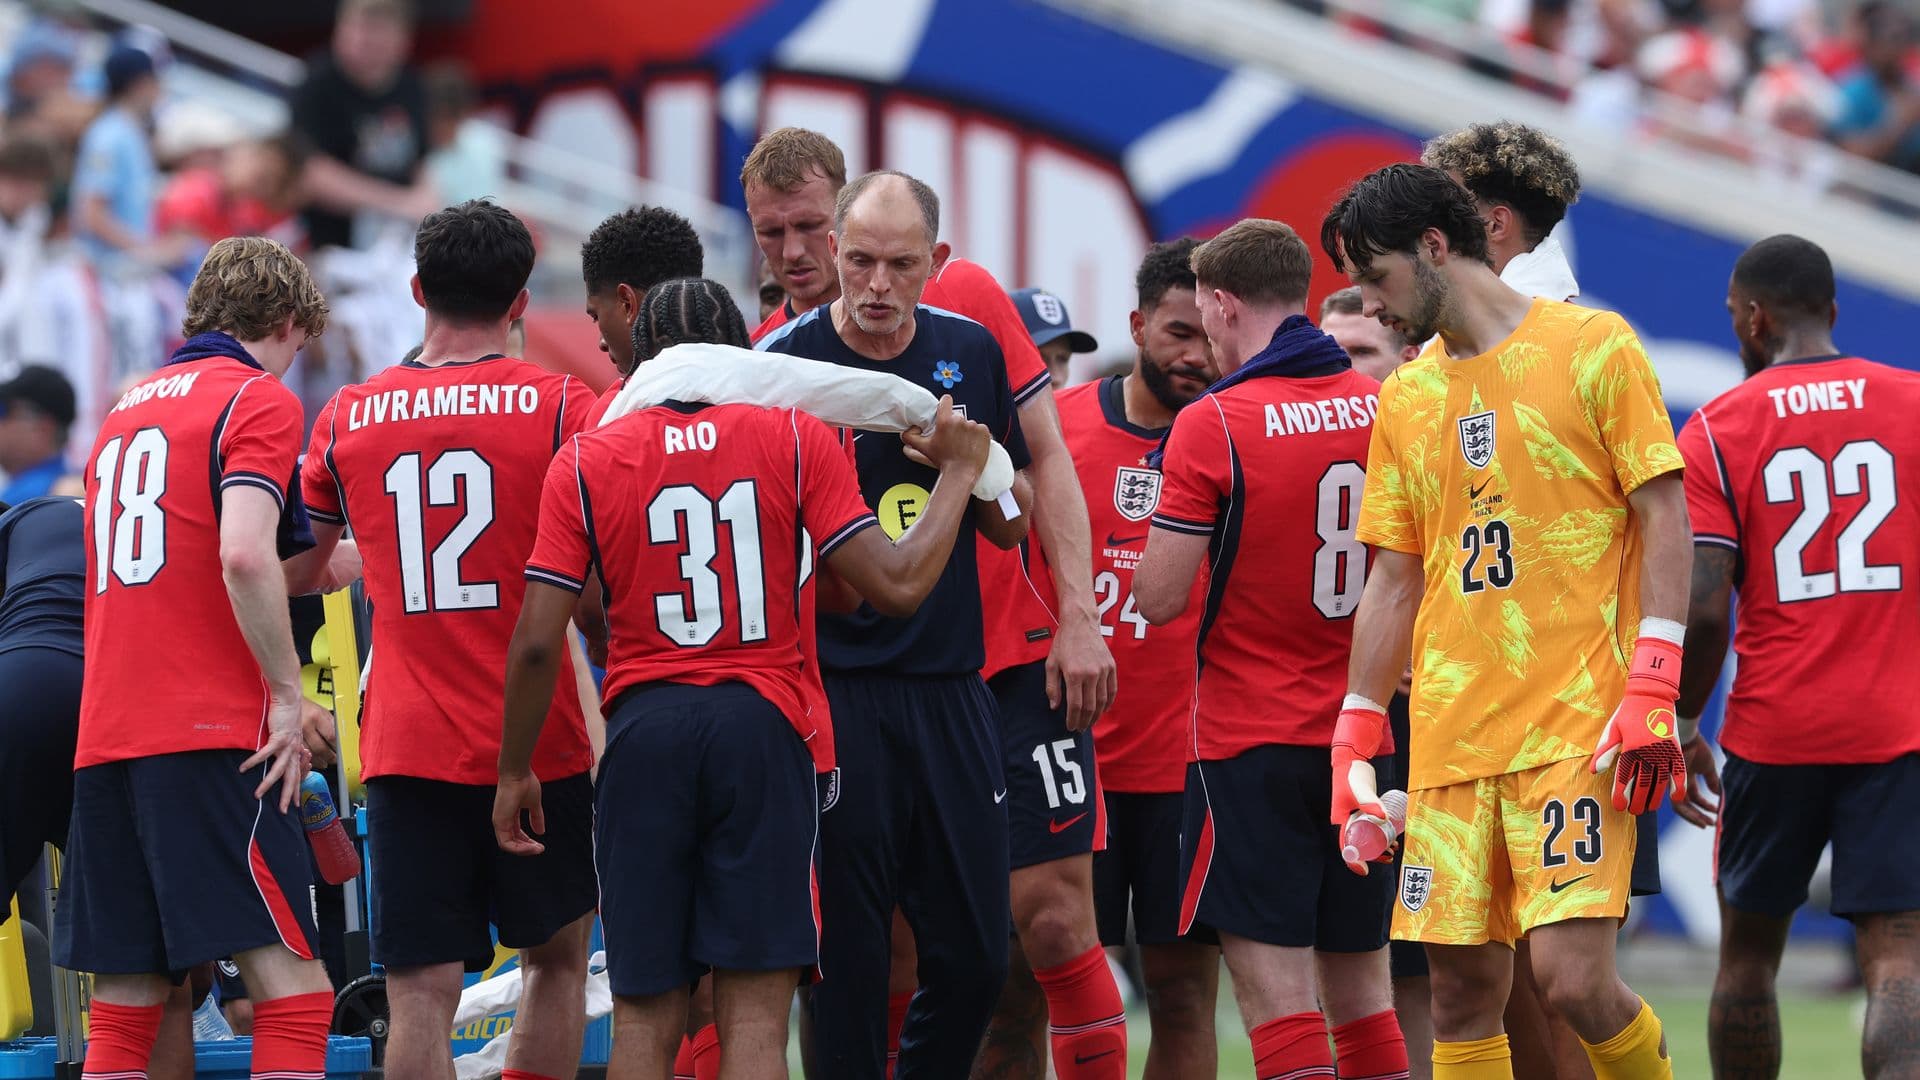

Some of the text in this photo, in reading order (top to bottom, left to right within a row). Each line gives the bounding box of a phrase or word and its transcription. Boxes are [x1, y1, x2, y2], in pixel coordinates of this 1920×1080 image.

[109, 371, 200, 414] ORDON
[349, 384, 538, 432] LIVRAMENTO
[1264, 393, 1379, 438] ANDERSO
[1767, 378, 1866, 418] TONEY
[664, 421, 717, 454] RIO
[93, 425, 169, 597] 18
[384, 448, 500, 616] 12
[1313, 460, 1369, 620] 8
[1762, 438, 1903, 604] 22
[646, 478, 769, 648] 31
[1103, 549, 1143, 560] NEW ZEALA
[1461, 519, 1515, 595] 23
[1094, 570, 1150, 639] 24
[1031, 738, 1087, 809] 15
[1541, 796, 1602, 869] 23
